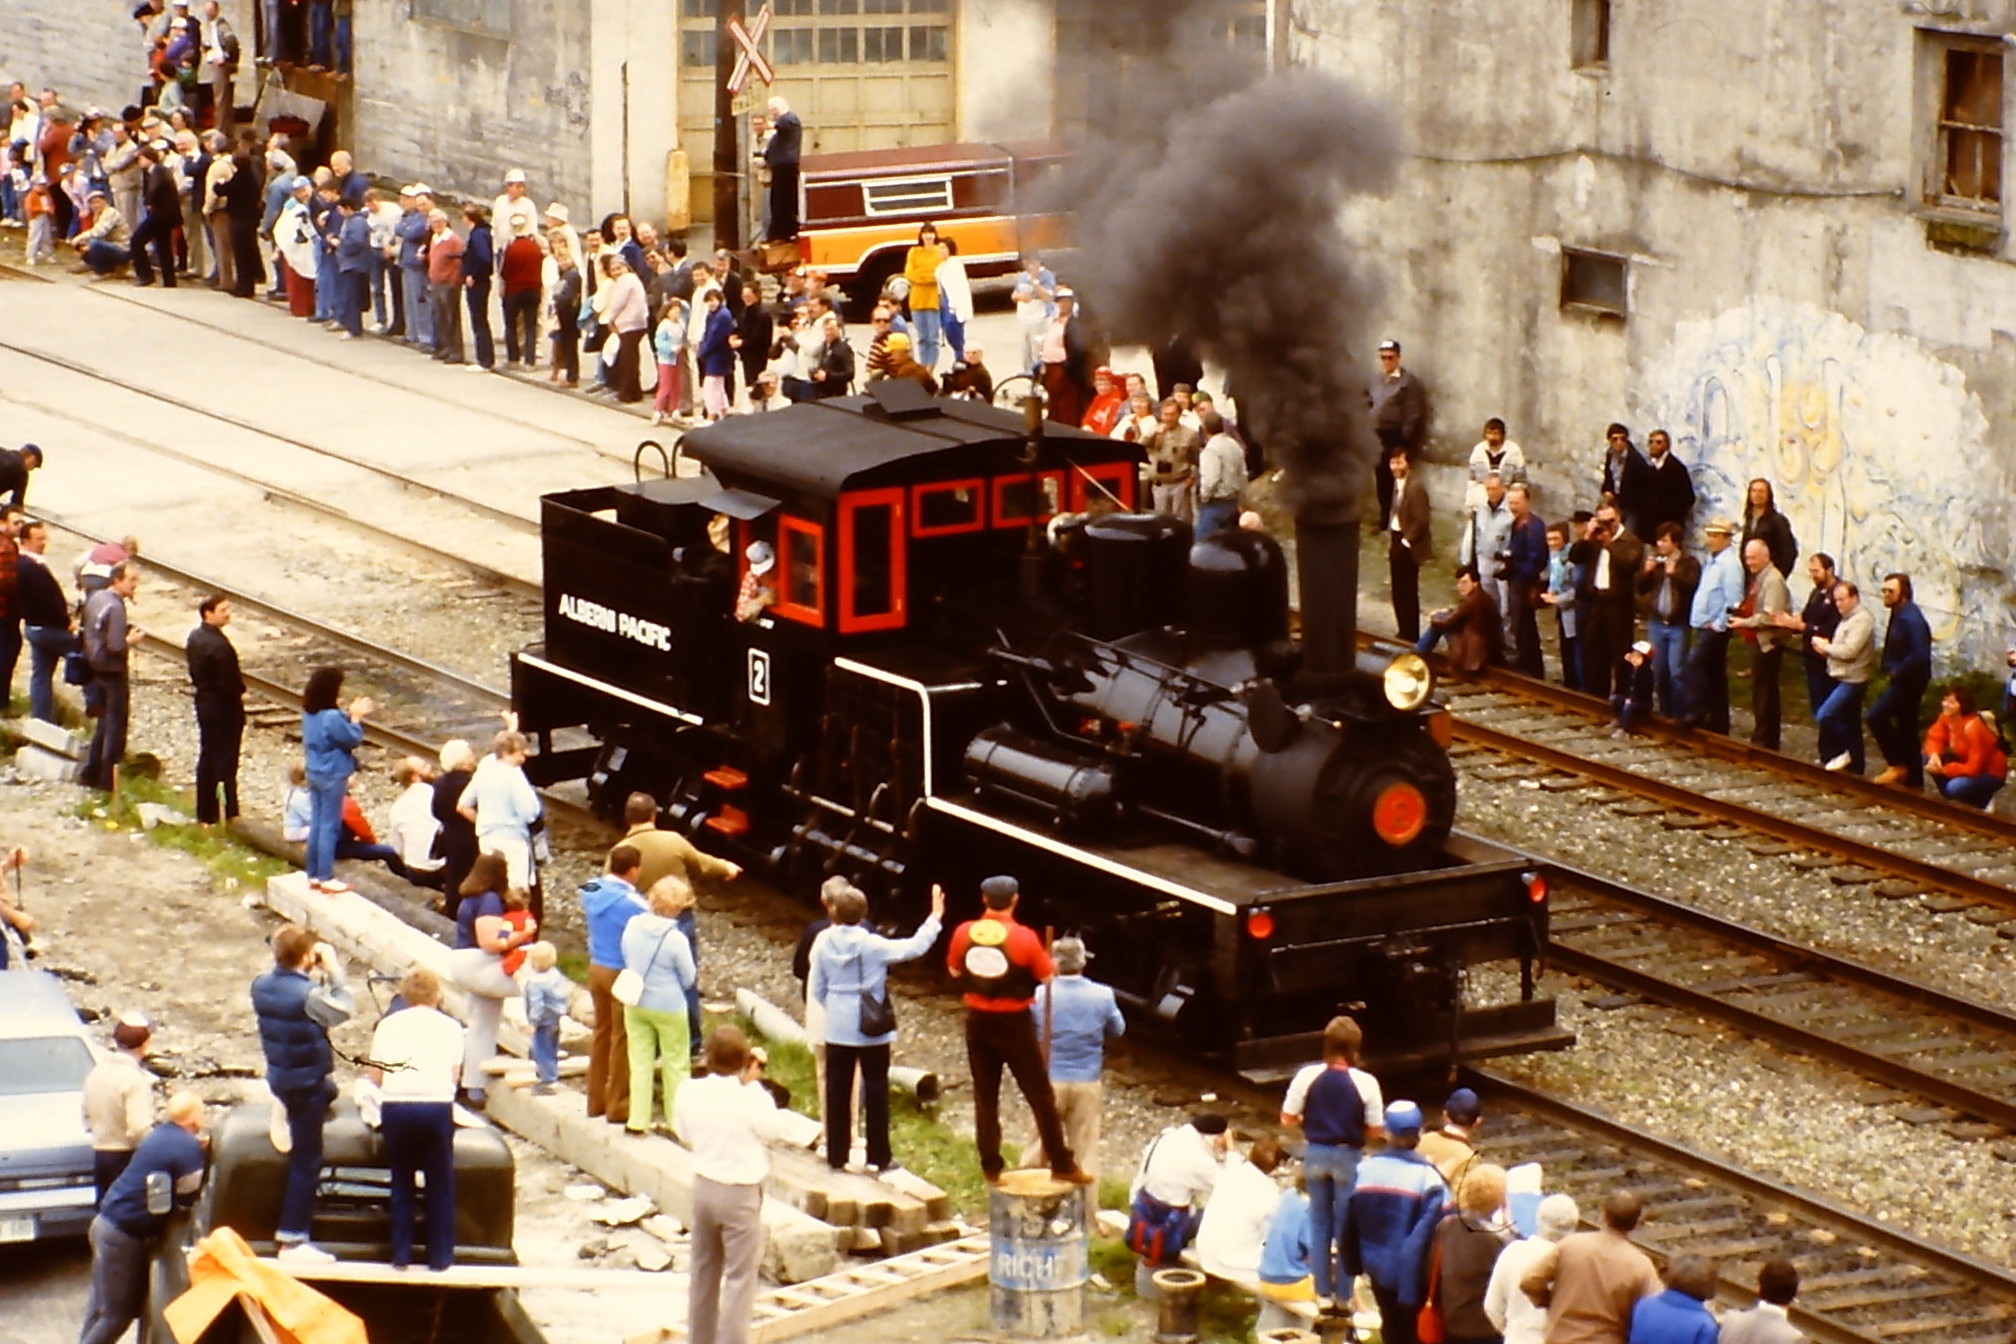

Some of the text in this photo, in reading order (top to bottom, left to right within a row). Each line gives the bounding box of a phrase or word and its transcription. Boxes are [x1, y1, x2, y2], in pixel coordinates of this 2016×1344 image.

[559, 593, 671, 651] ALBERNI PACIFIC
[753, 660, 764, 693] 2
